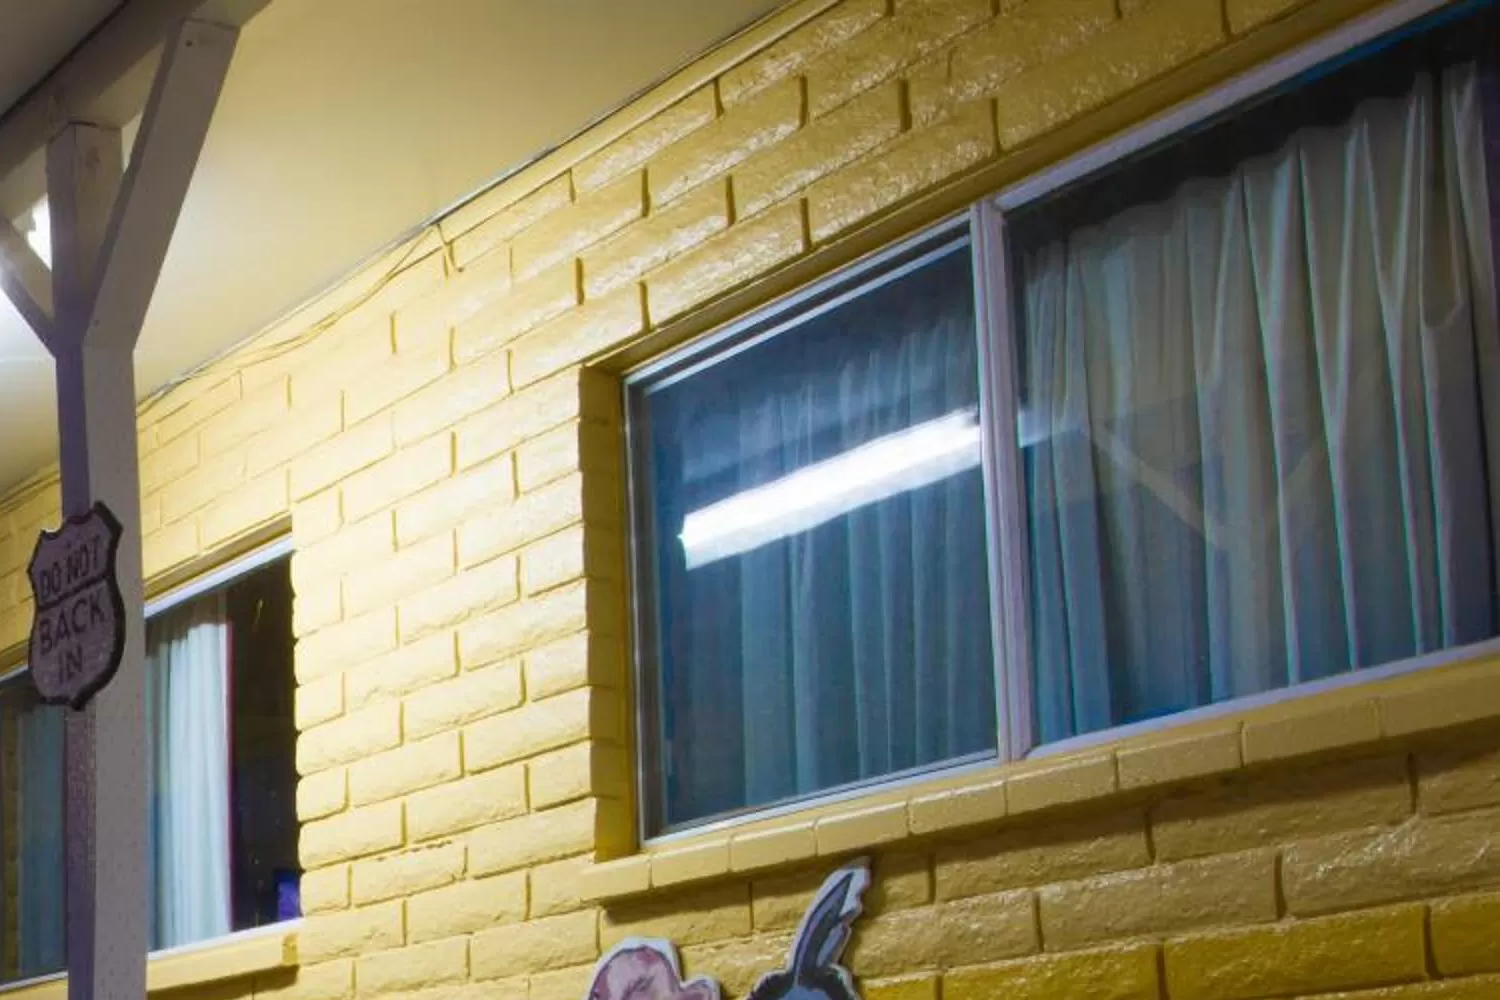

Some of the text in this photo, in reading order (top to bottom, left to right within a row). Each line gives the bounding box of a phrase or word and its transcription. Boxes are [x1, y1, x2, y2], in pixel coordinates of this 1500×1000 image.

[40, 536, 101, 599] DO NOT
[39, 594, 105, 655] BACK
[58, 643, 83, 684] IN
